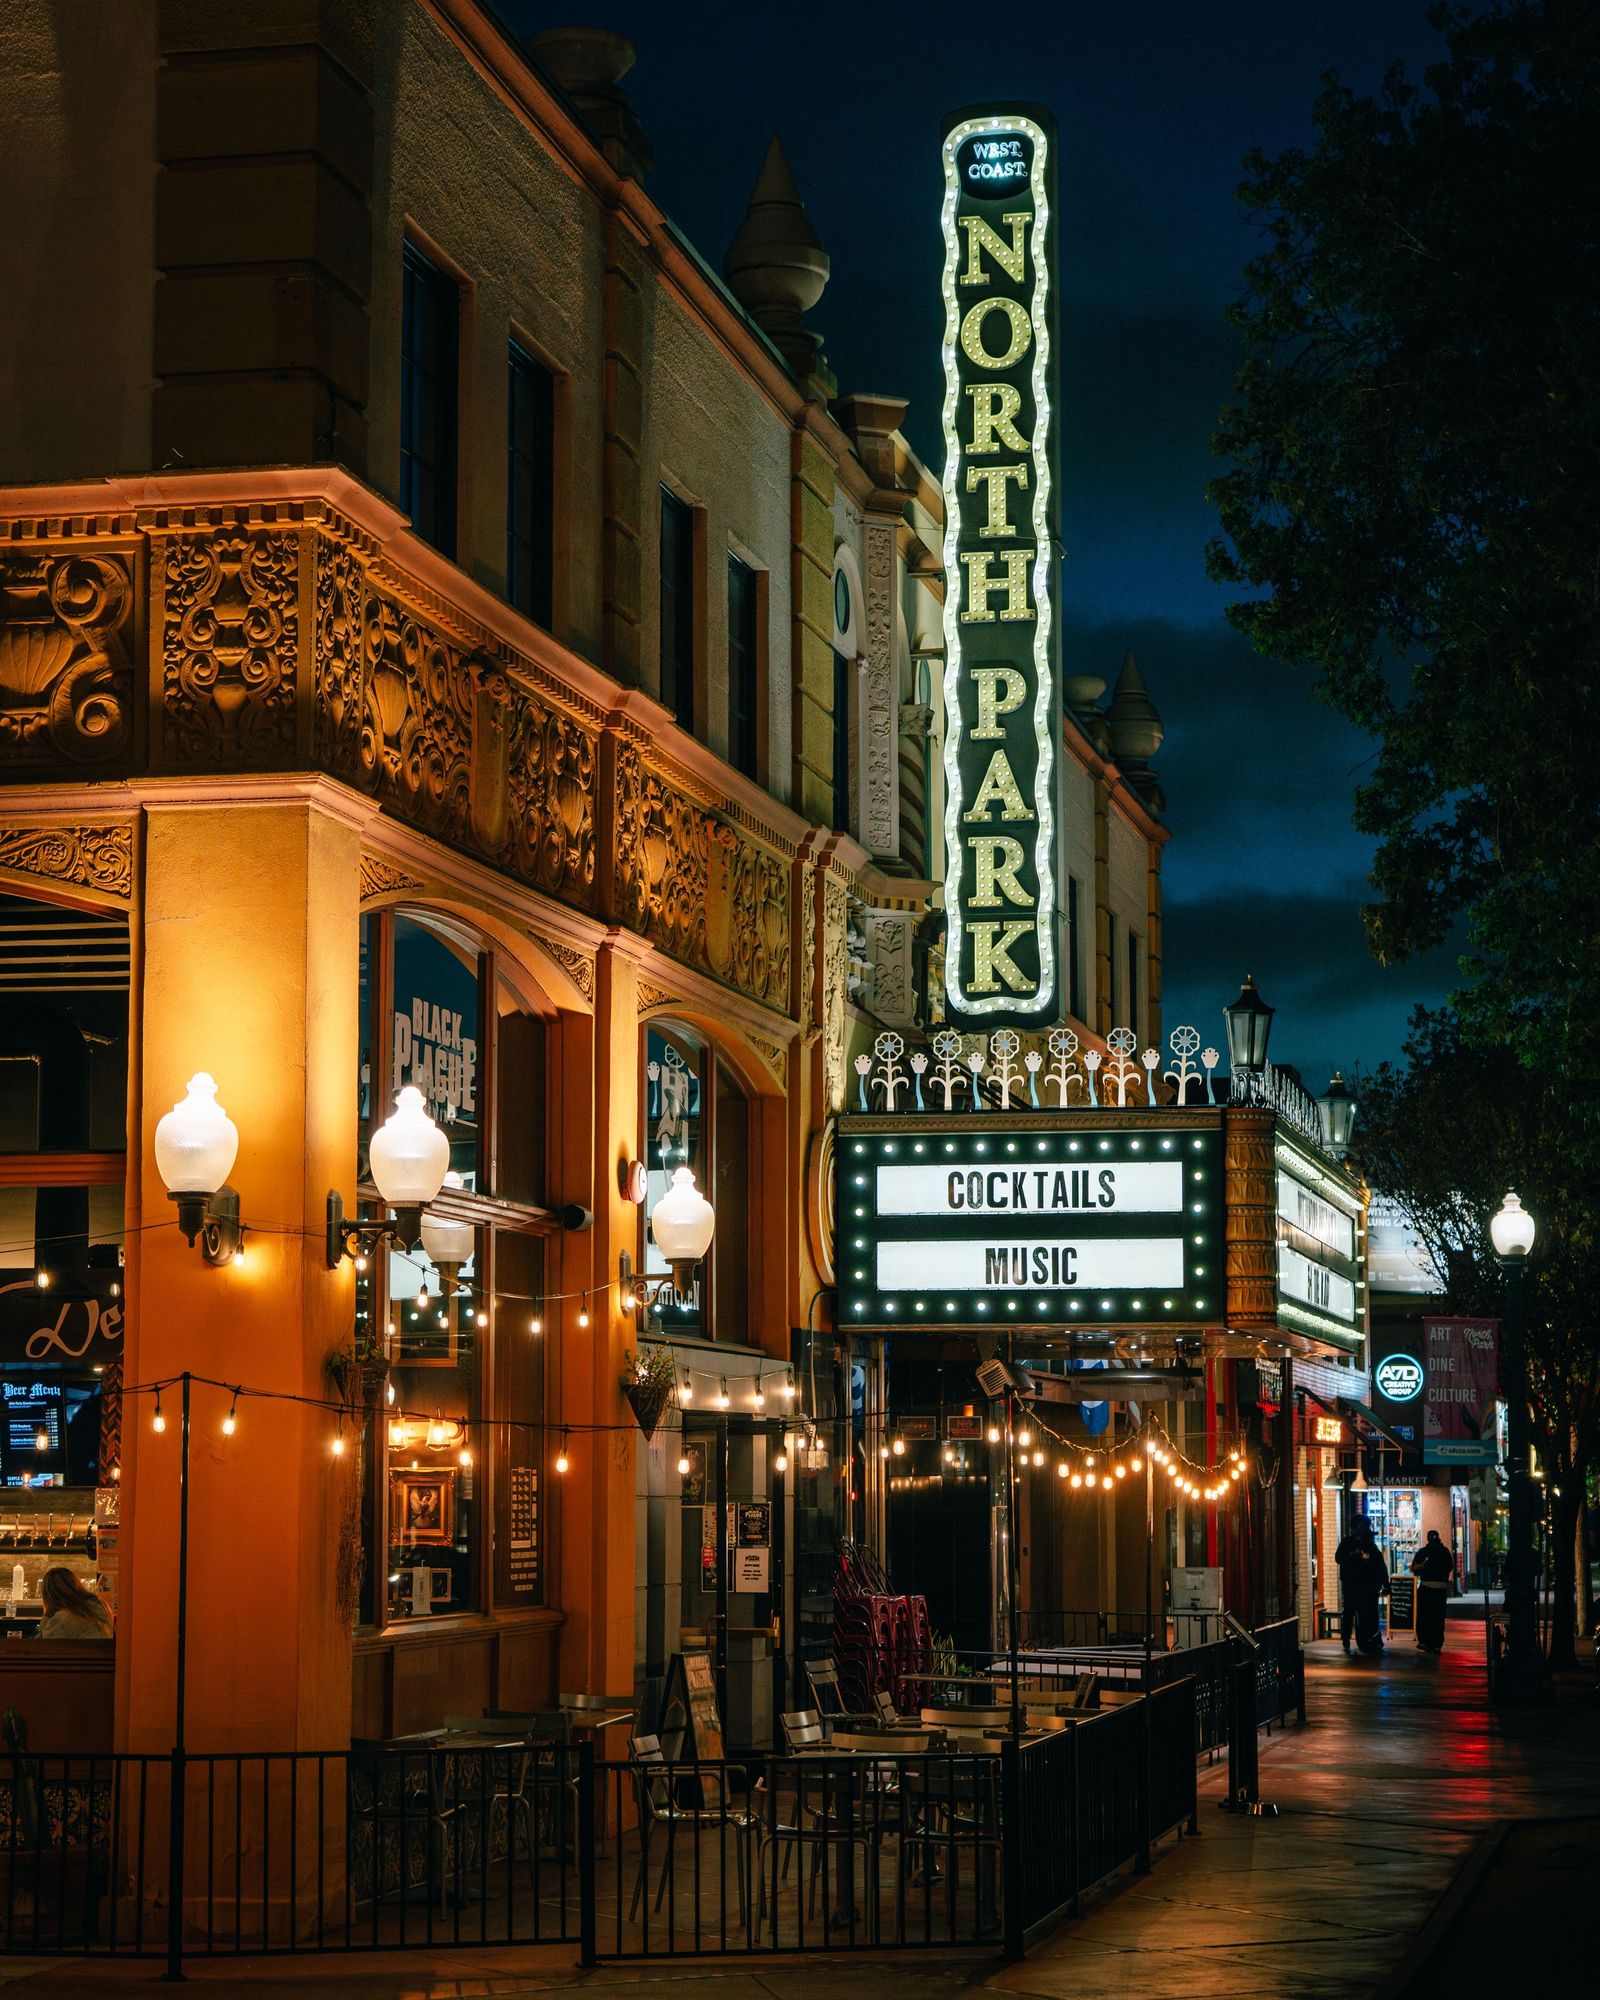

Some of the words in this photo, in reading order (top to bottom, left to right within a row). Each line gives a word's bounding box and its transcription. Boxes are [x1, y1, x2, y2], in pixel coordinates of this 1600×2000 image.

[973, 141, 1021, 159] WEST
[968, 161, 1026, 179] COAST
[958, 212, 1035, 624] NORTH
[963, 668, 1037, 993] PARK
[412, 996, 462, 1050] BLACK
[394, 1011, 476, 1113] PLAGUE
[947, 1168, 1116, 1210] COCKTAILS
[1367, 1217, 1391, 1227] LUNG
[984, 1246, 1078, 1286] MUSIC
[1430, 1327, 1452, 1341] ART
[1428, 1357, 1456, 1373] DINE
[2, 1382, 28, 1400] Beer
[1383, 1380, 1416, 1389] CREATIVE
[1387, 1387, 1413, 1396] GROUP
[1428, 1388, 1478, 1404] CULTURE
[1385, 1477, 1429, 1485] MARKET
